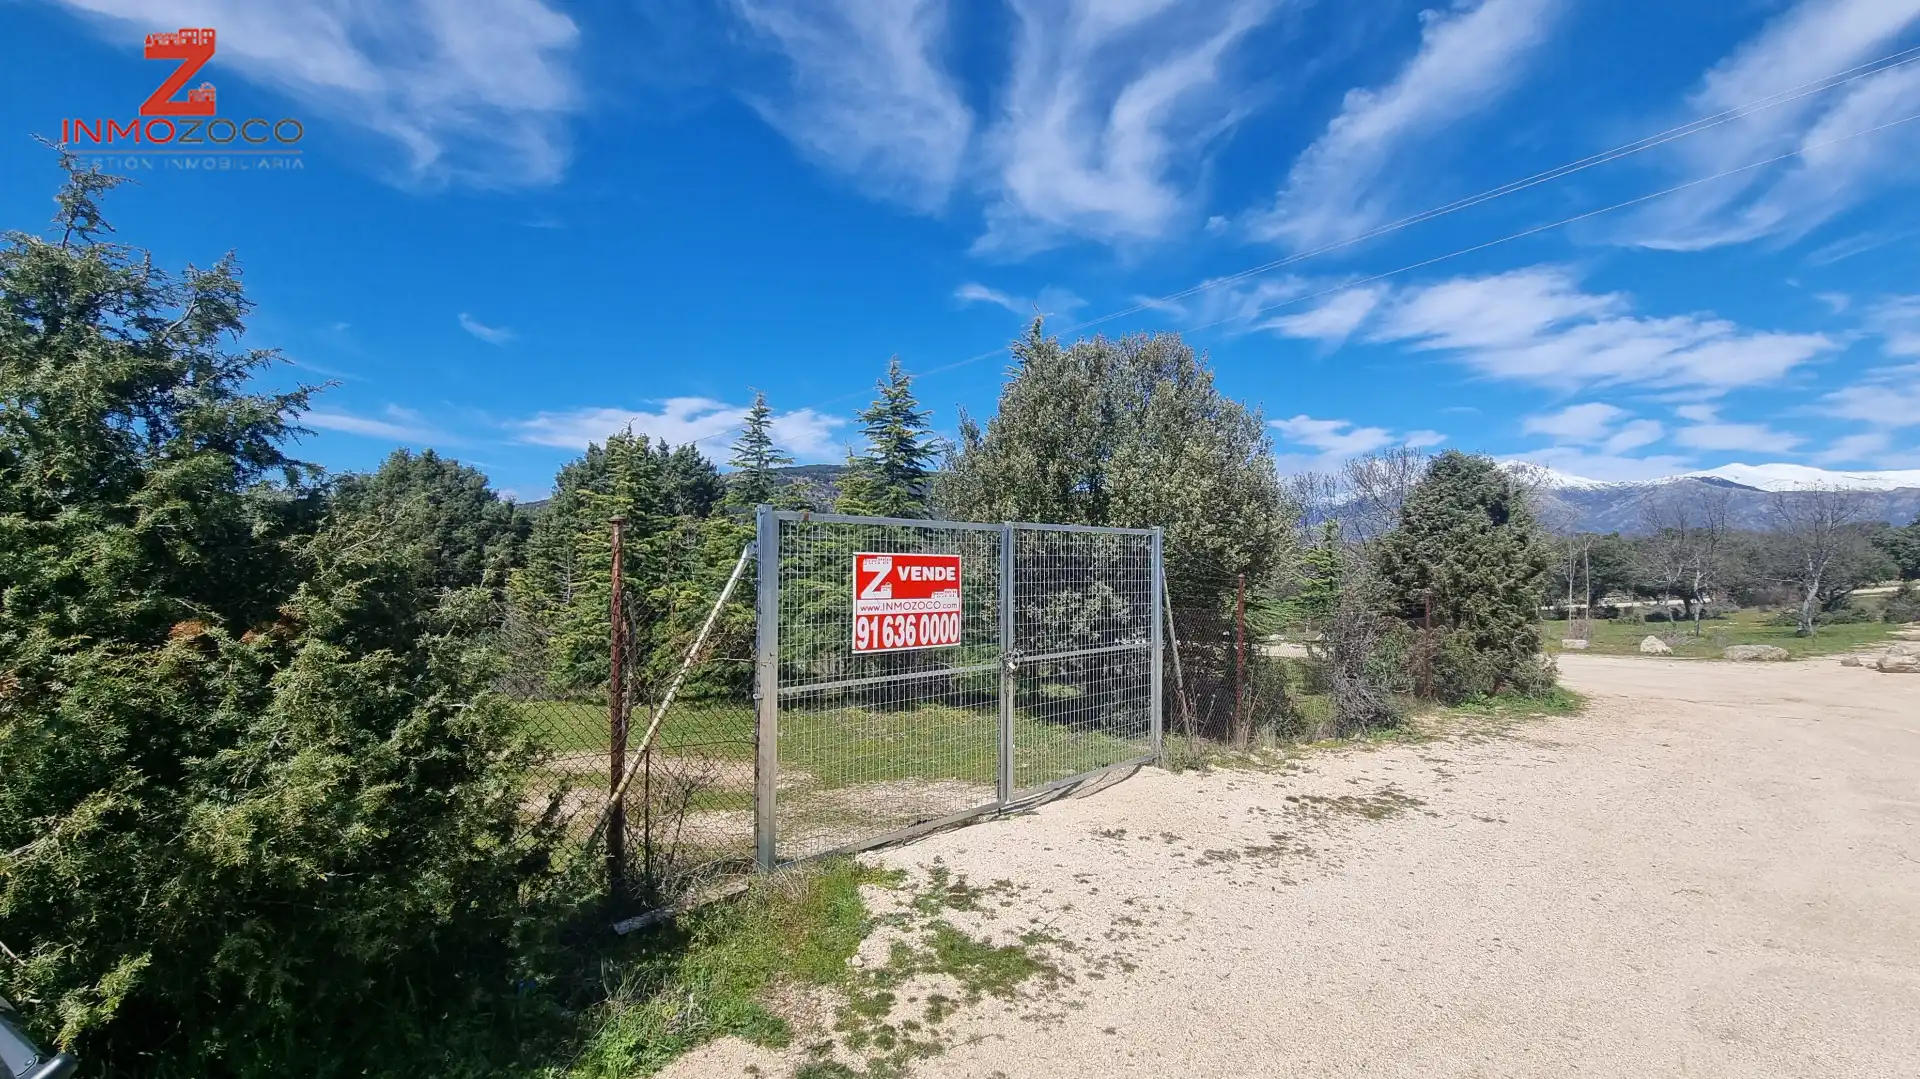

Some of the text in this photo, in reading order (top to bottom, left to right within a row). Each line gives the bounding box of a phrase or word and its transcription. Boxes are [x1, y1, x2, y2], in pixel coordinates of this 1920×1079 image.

[861, 557, 956, 599] Z VENDE
[860, 601, 957, 611] www.INMOZOCO.com
